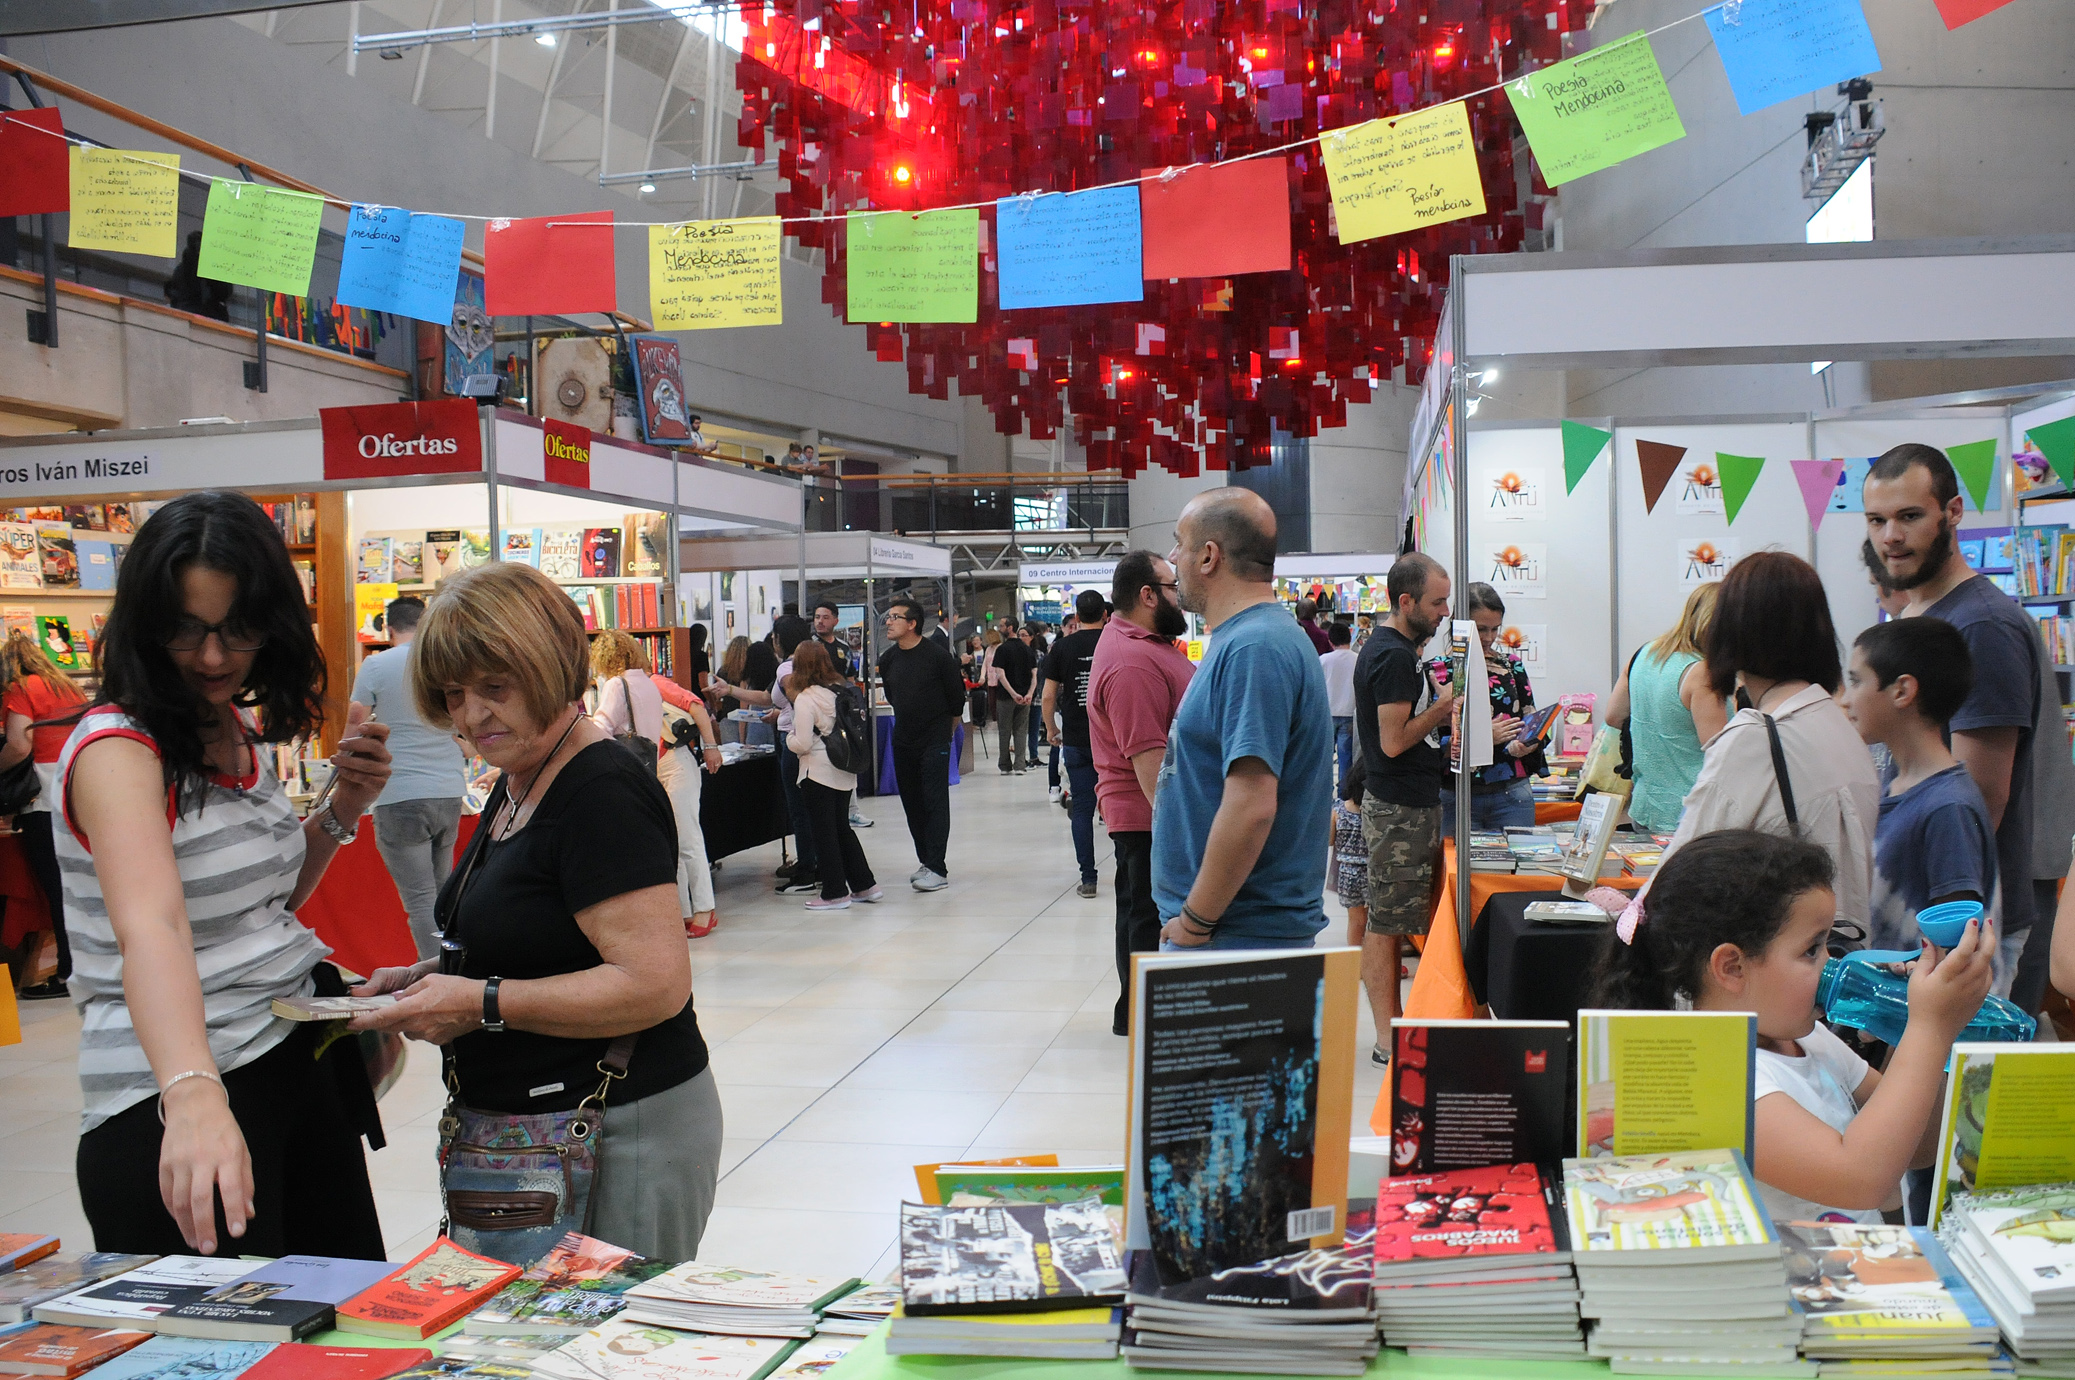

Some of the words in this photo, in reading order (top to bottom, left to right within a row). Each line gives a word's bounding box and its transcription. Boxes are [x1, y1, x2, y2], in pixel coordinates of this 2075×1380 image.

[1542, 72, 1588, 100] Poesía
[1553, 79, 1626, 119] Mendocina
[1413, 198, 1473, 218] mendocina
[664, 249, 747, 270] Mendocina
[358, 433, 458, 459] Ofertas
[544, 433, 588, 464] Ofertas
[0, 465, 28, 483] ros
[36, 460, 77, 481] Iván
[84, 456, 149, 478] Miszei
[542, 544, 578, 555] BICICLETA
[627, 561, 660, 572] Caballos
[1069, 567, 1114, 576] Internacion
[361, 602, 384, 610] Mafal
[1411, 1228, 1519, 1242] MACABROS
[1446, 1236, 1521, 1246] JUEGOS
[1879, 1312, 1945, 1322] Juan
